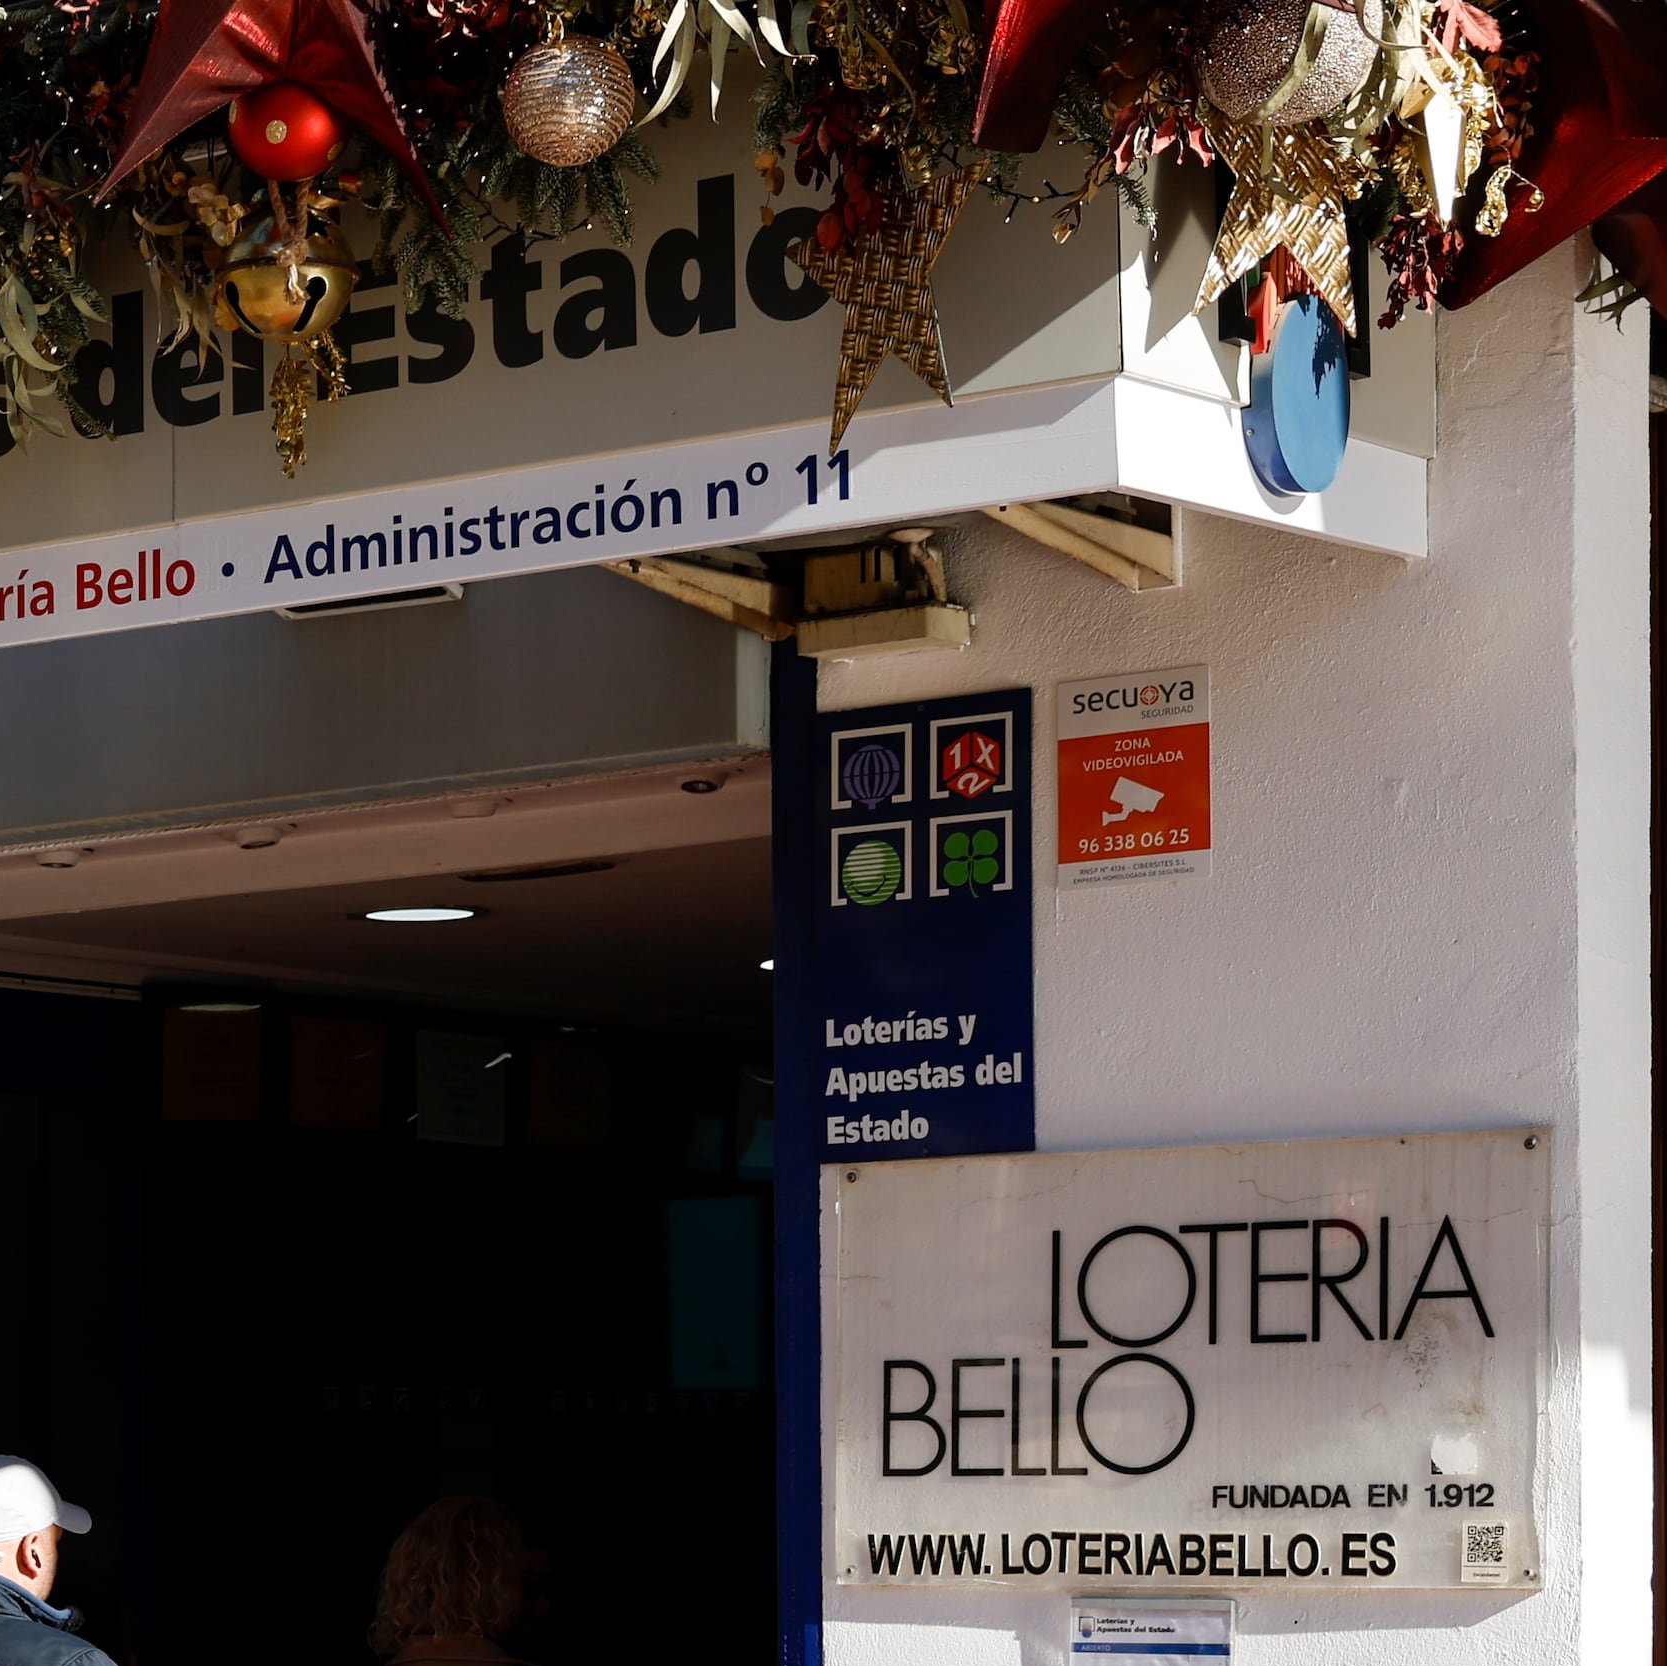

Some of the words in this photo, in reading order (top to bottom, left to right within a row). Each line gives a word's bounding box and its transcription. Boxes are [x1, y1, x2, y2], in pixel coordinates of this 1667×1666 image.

[76, 549, 196, 610] Bello
[264, 475, 682, 582] Administración
[796, 450, 853, 504] 11
[1141, 705, 1194, 719] SEGURIDAD
[1114, 737, 1151, 752] ZONA
[1082, 750, 1184, 772] VIDEOVIGILADA
[1079, 838, 1100, 855] 96
[1104, 833, 1135, 852] 338
[1140, 831, 1164, 848] 06
[1169, 828, 1190, 846] 25
[825, 1010, 949, 1047] Loterías
[958, 1012, 978, 1045] y
[825, 1060, 966, 1102] Apuestas
[975, 1052, 1023, 1085] del
[826, 1110, 930, 1145] Estado
[1051, 1214, 1496, 1350] LOTERIA
[881, 1352, 1196, 1478] BELLO
[1211, 1484, 1351, 1510] FUNDADA
[1368, 1483, 1409, 1509] EN
[1424, 1482, 1496, 1509] 1.912
[1081, 1644, 1111, 1652] ABIERTO
